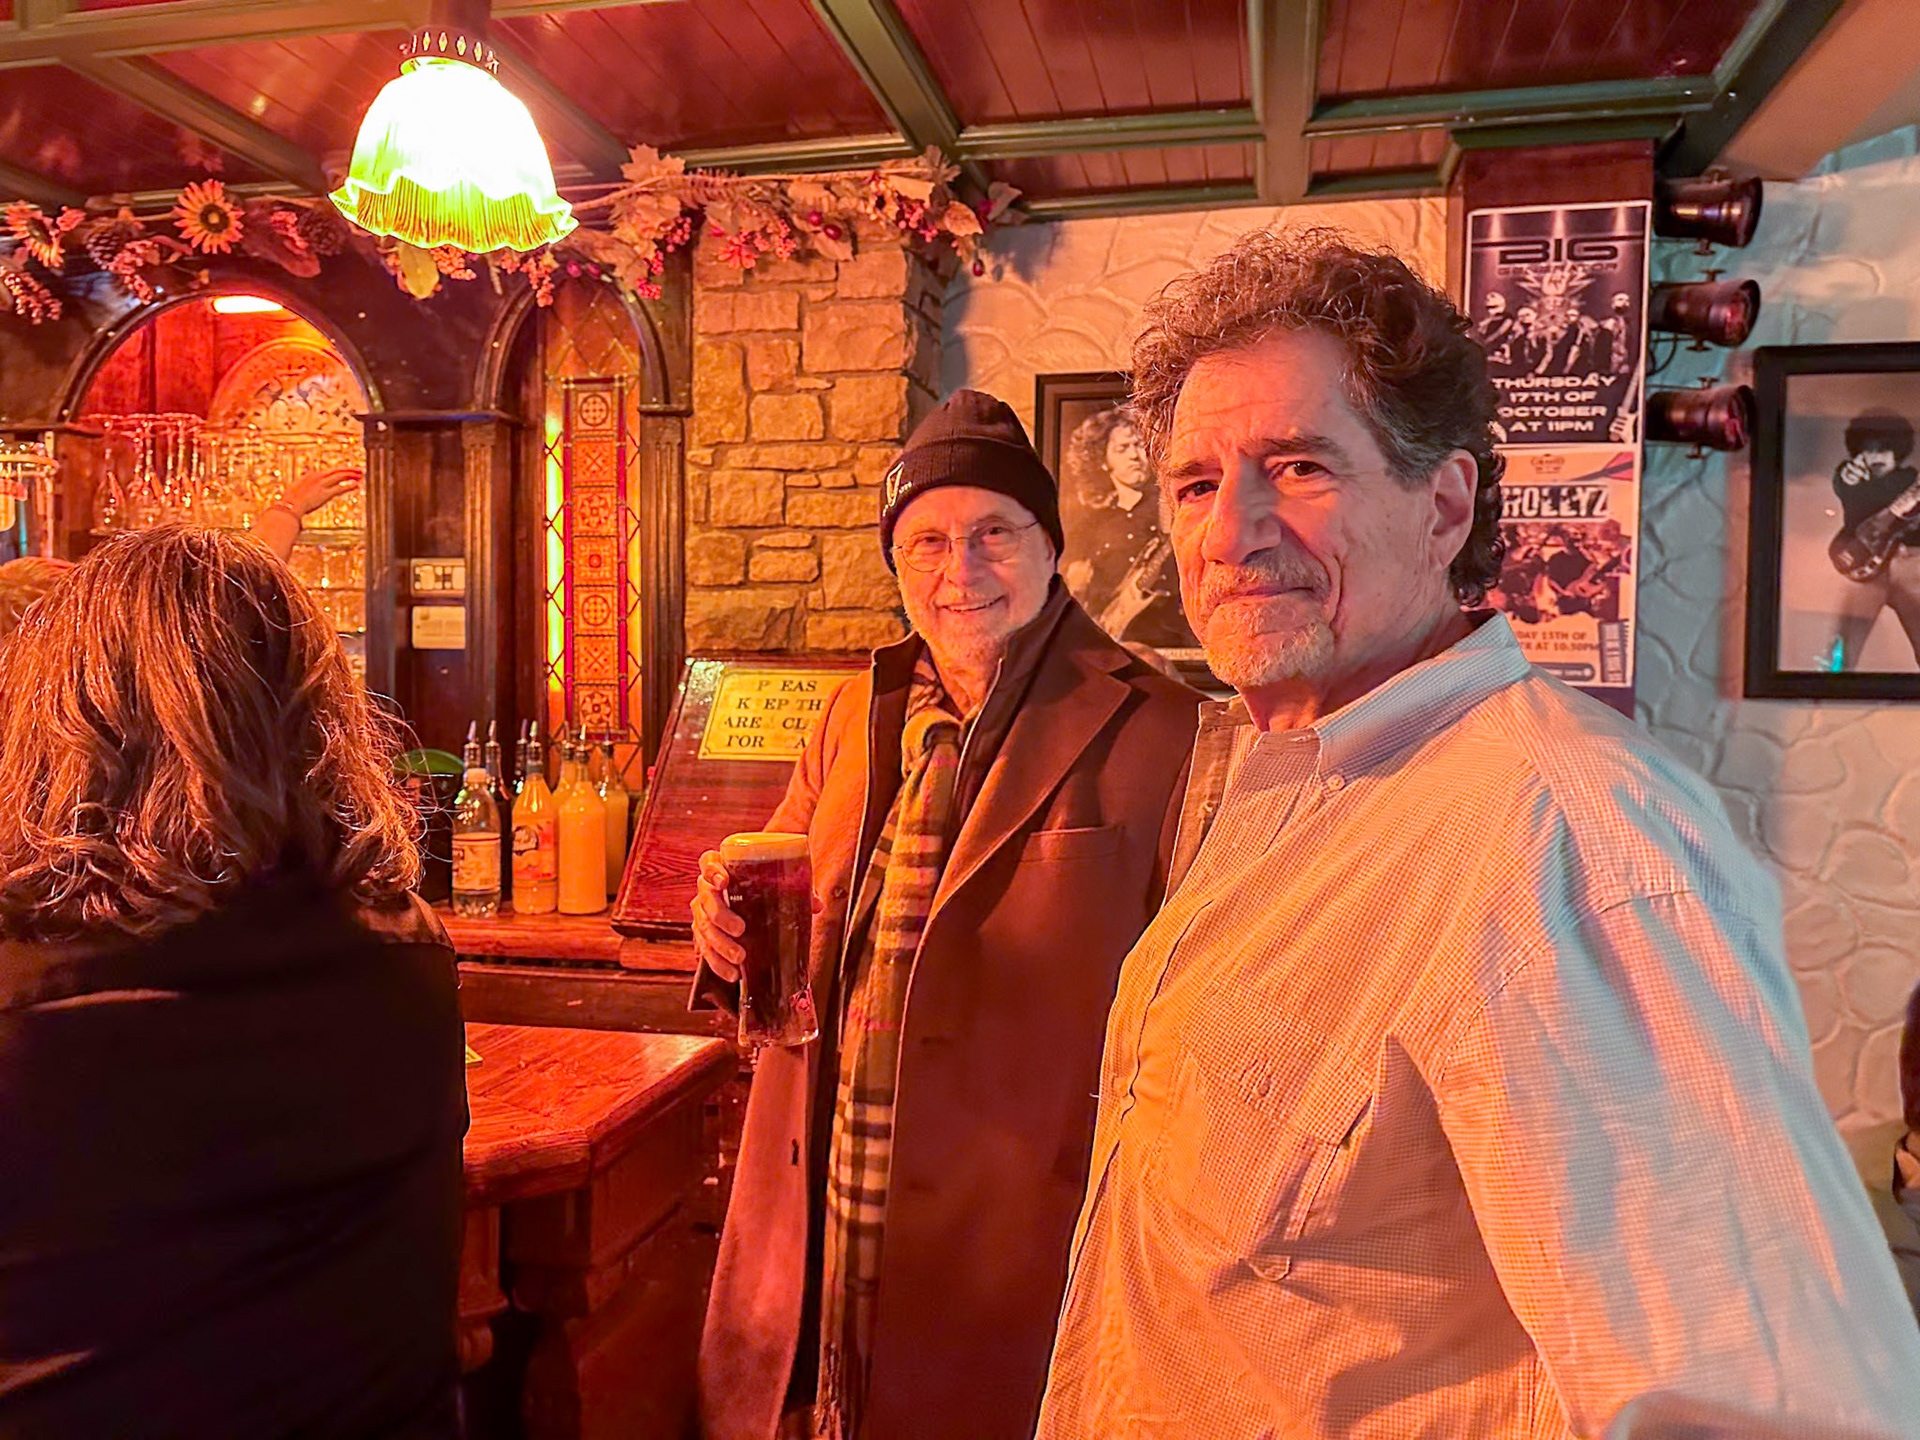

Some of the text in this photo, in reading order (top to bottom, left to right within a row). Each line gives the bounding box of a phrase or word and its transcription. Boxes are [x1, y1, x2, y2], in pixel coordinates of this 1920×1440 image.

[1499, 237, 1618, 264] BIG
[1492, 374, 1616, 389] THURSDAY
[1510, 391, 1597, 403] 17TH OF
[1497, 406, 1607, 418] OCTOBER
[1509, 421, 1594, 432] AT 11PM
[1515, 630, 1538, 640] DAY
[736, 698, 789, 710] KEP
